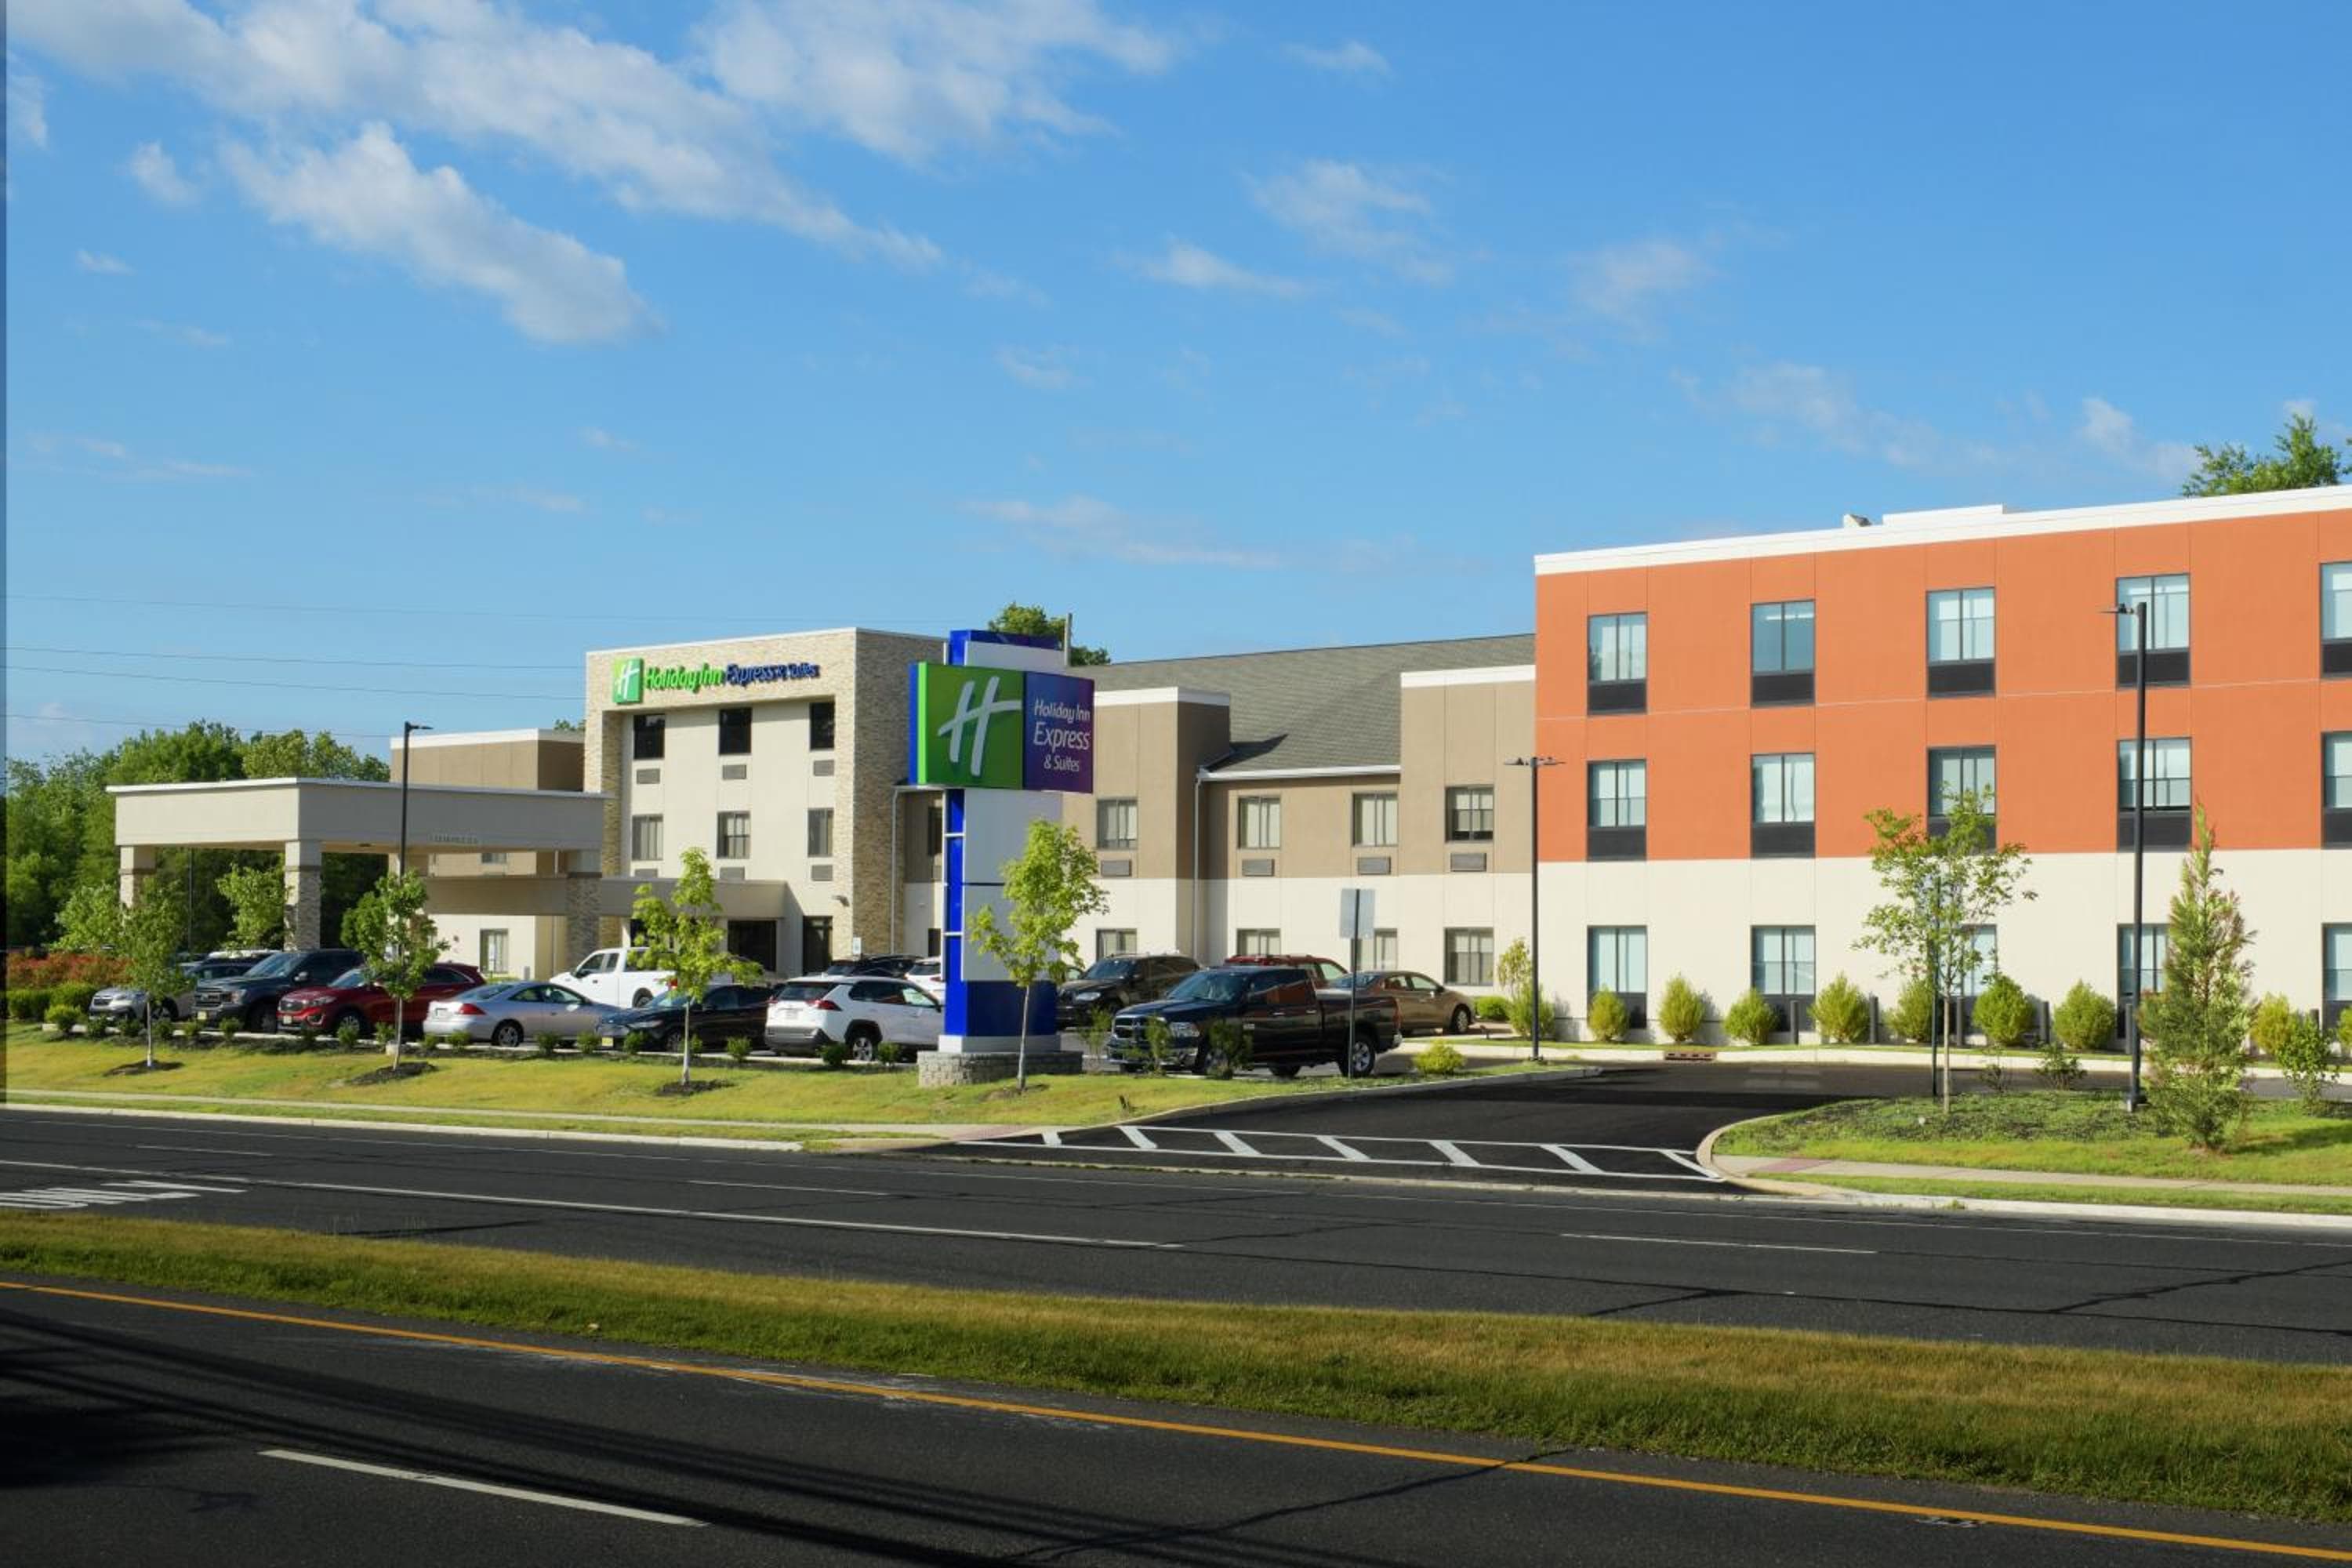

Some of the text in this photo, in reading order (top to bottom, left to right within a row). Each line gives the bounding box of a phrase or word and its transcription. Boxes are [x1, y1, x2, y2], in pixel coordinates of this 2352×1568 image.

[645, 666, 700, 693] Holiday
[700, 662, 726, 686] Inn
[726, 664, 777, 688] Express
[1034, 697, 1091, 724] Holiday Inn
[938, 677, 1022, 776] H
[1033, 721, 1091, 753] Express
[1044, 753, 1080, 772] & Suites
